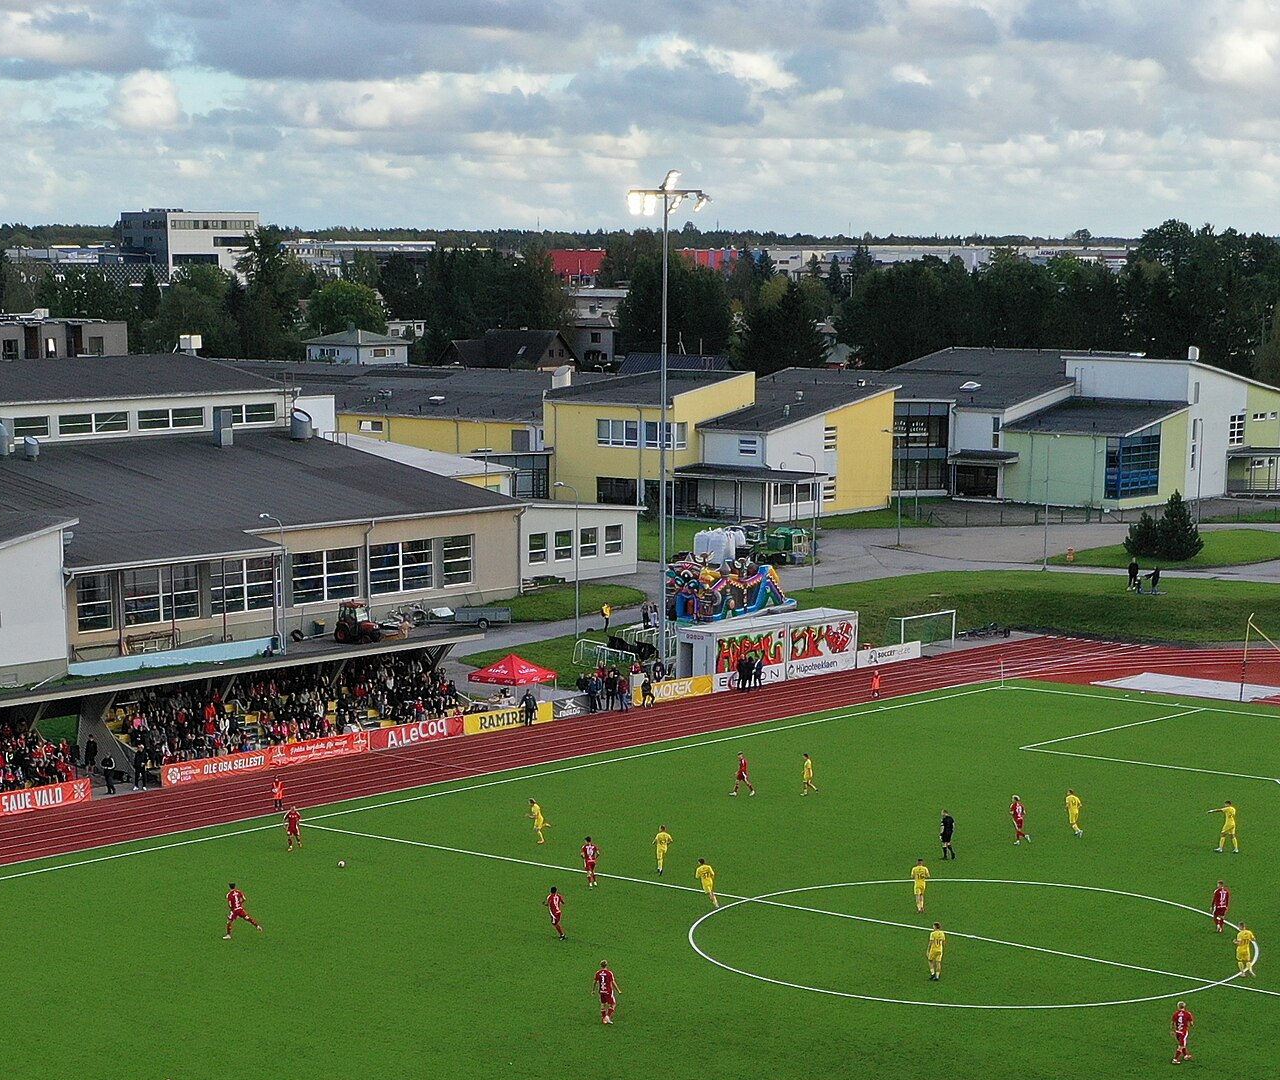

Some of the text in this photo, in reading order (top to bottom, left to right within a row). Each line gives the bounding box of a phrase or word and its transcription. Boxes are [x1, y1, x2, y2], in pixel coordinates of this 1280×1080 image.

[796, 659, 838, 674] Hüpoteeklaen
[203, 763, 217, 775] OLE
[218, 761, 233, 772] OSA
[233, 755, 265, 769] SELLEST!
[1, 787, 63, 813] SAUE VALD
